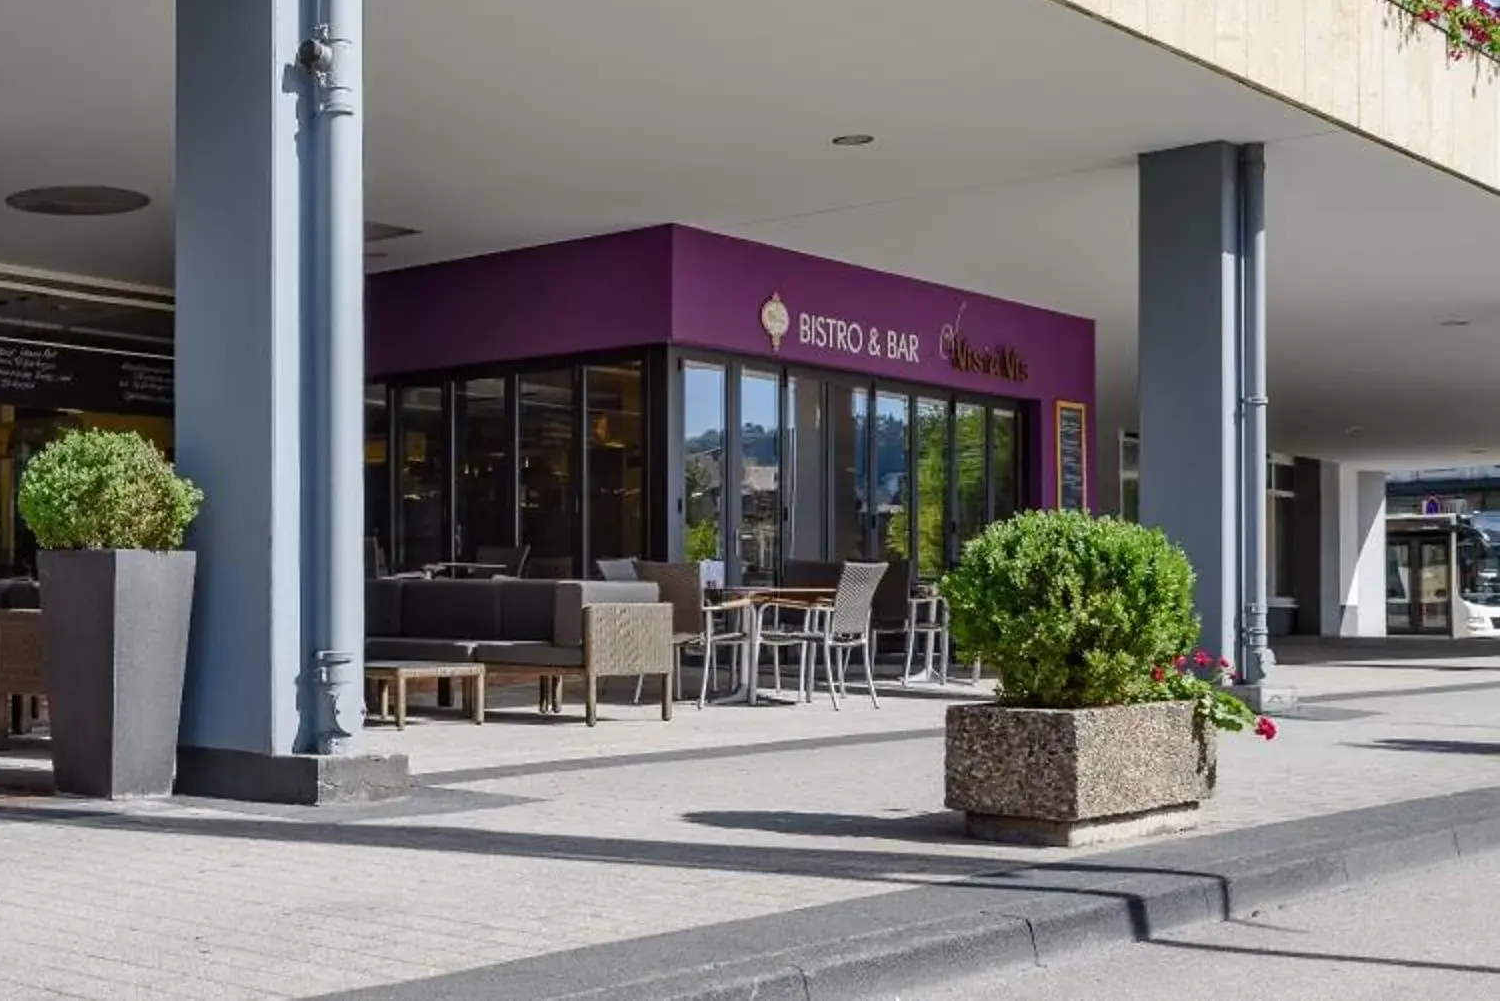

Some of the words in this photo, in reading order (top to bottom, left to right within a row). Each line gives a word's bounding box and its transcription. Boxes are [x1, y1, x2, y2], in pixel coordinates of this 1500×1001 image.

[799, 312, 863, 355] BISTRO
[867, 326, 881, 358] &
[887, 328, 920, 363] BAR
